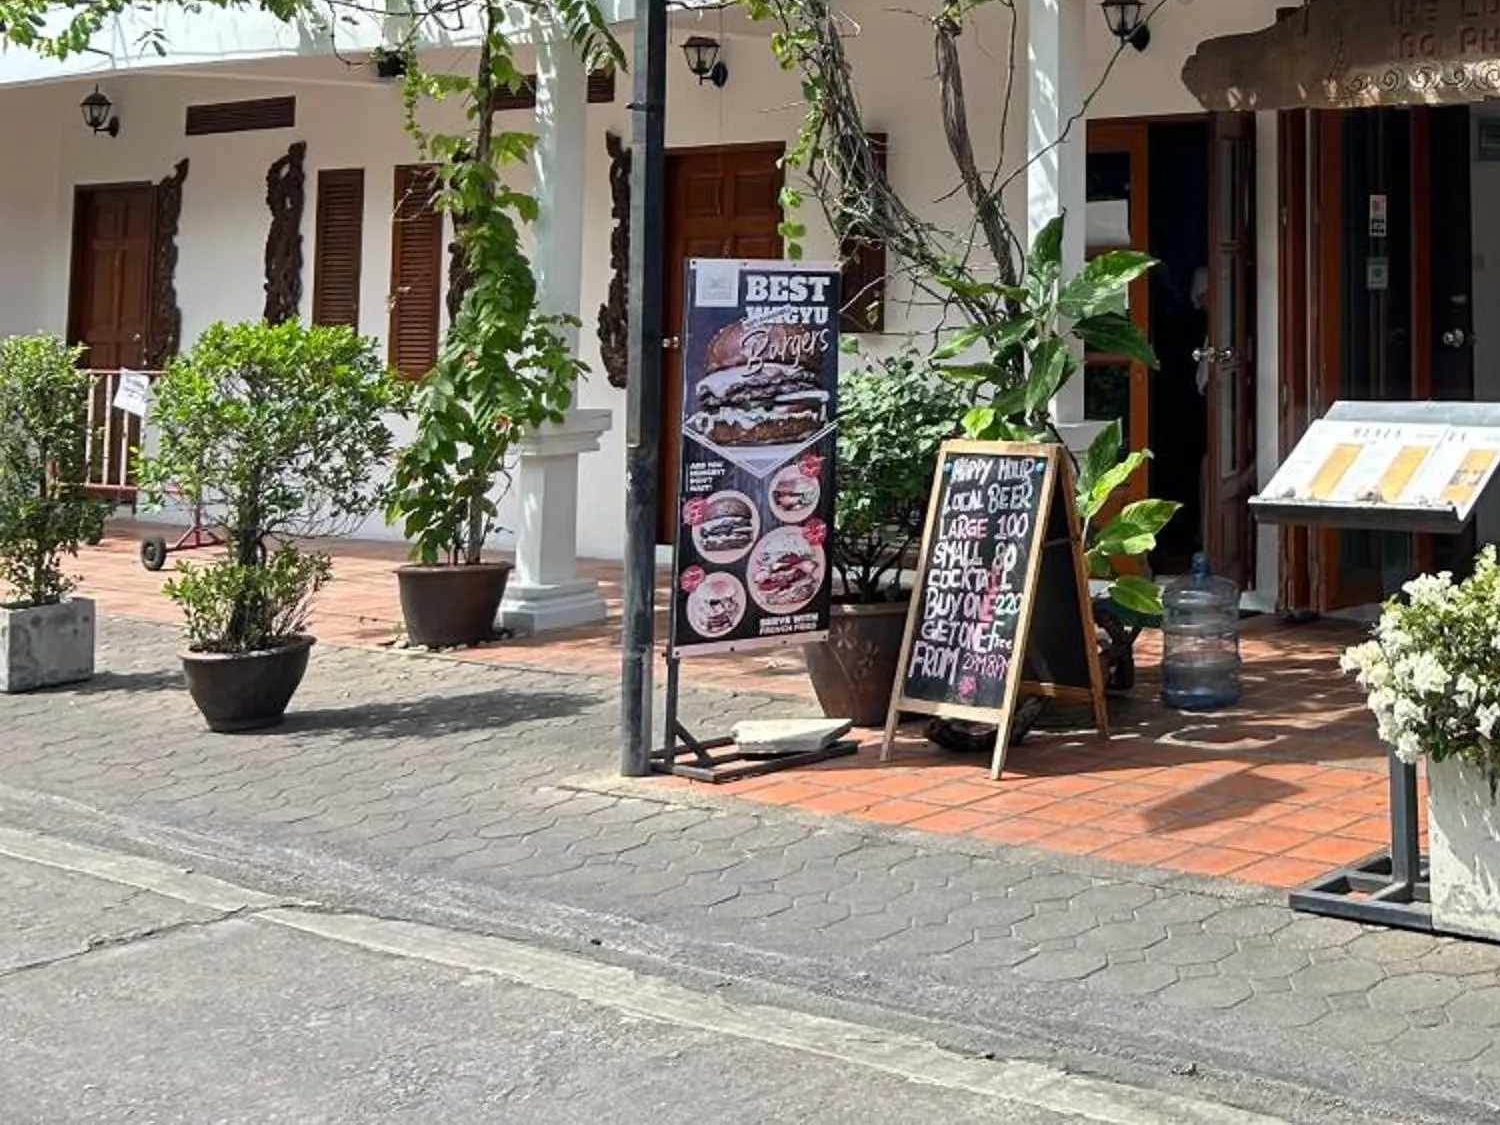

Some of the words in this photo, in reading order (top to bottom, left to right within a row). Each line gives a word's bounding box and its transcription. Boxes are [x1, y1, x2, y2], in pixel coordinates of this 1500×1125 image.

[745, 275, 831, 303] BEST
[741, 328, 830, 377] Burgers
[950, 457, 994, 485] HAPPY
[997, 457, 1035, 482] HOUR
[942, 486, 985, 515] LOCAL
[988, 483, 1033, 514] BEER
[939, 514, 989, 540] LARGE
[994, 512, 1029, 540] 100
[933, 541, 983, 569] SMALL
[991, 541, 1017, 571] 80
[924, 586, 963, 621] BUY
[963, 592, 993, 622] ONE
[921, 619, 960, 646] GET
[908, 640, 960, 686] FROM
